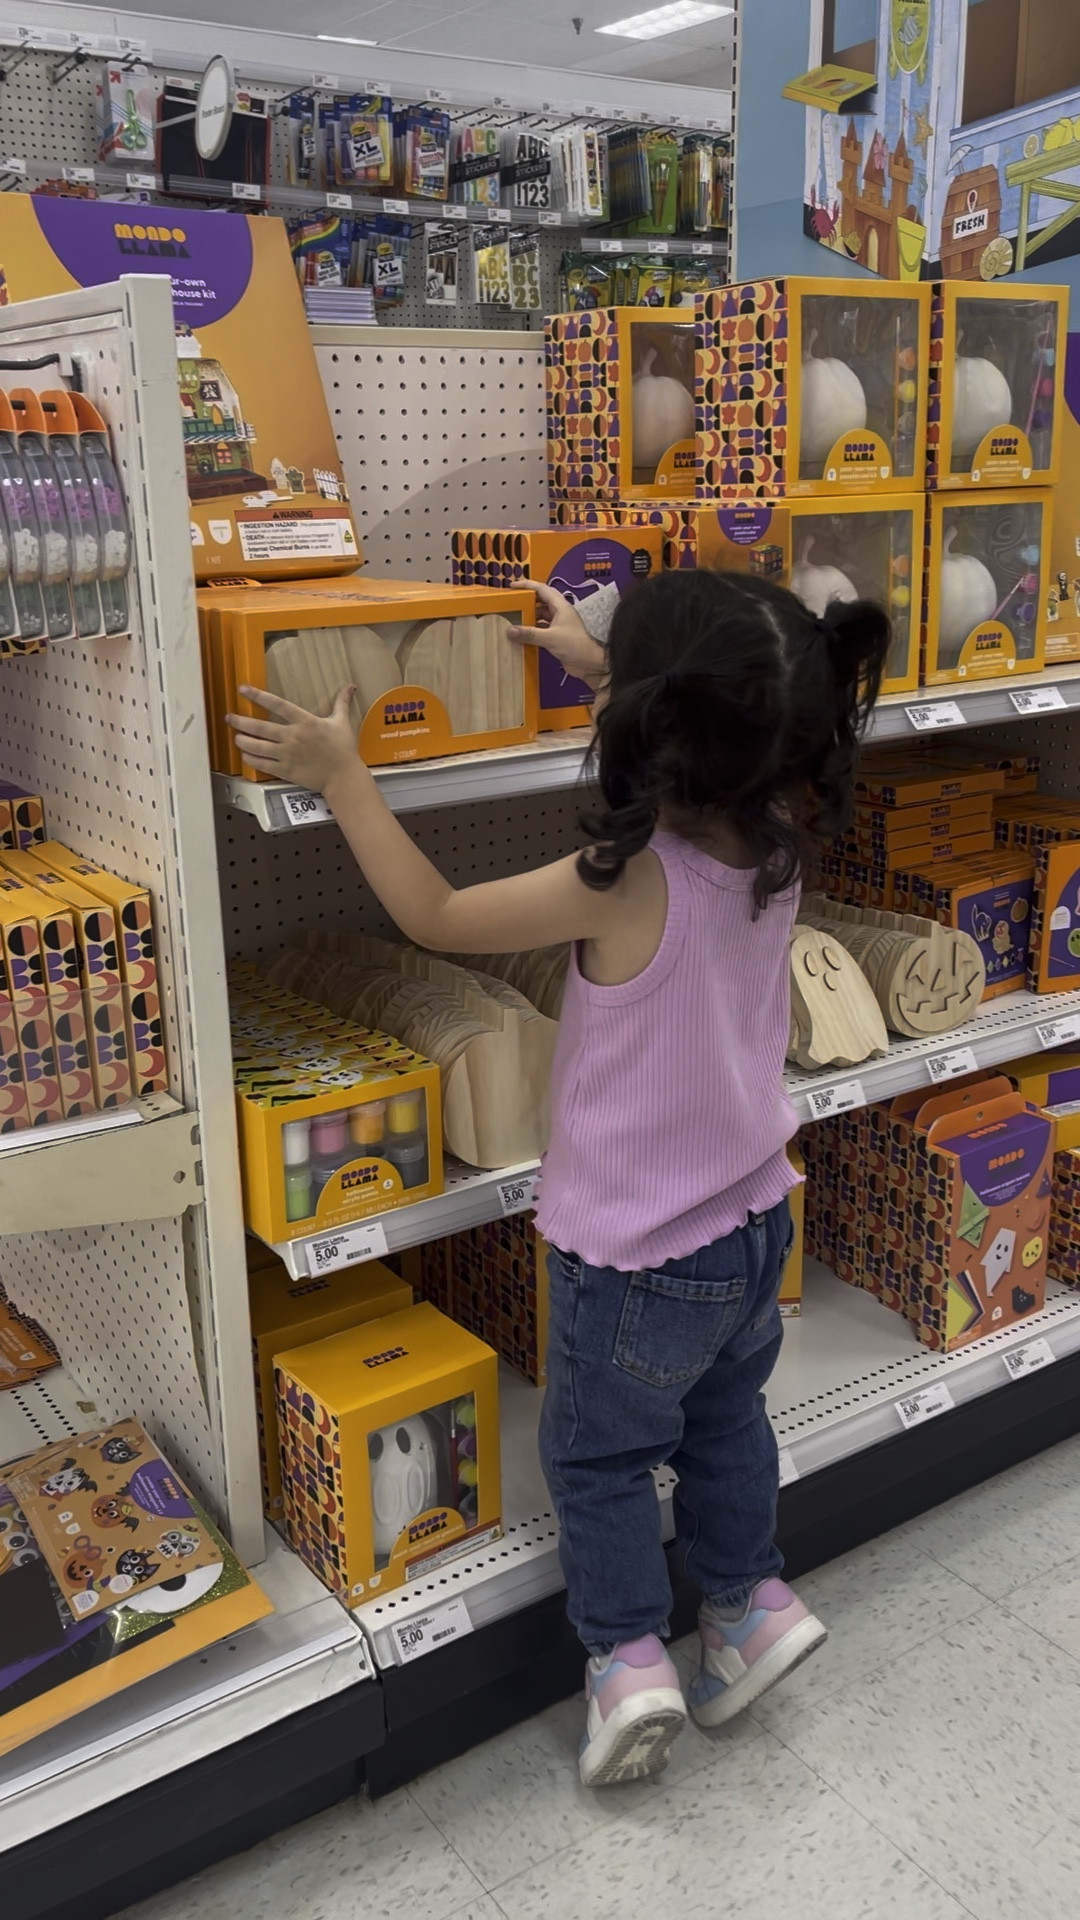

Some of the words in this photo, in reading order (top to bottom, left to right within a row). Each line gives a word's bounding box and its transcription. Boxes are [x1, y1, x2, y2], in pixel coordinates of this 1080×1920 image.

[353, 142, 378, 157] XL
[517, 183, 550, 207] !123
[955, 214, 985, 234] FRESH
[378, 262, 398, 276] XL
[202, 289, 217, 299] kit
[844, 453, 874, 462] LLAMA
[280, 510, 313, 519] WARNING
[384, 700, 425, 714] MONDO
[384, 711, 425, 726] LLAMA
[380, 730, 399, 739] wood
[290, 800, 316, 813] 5.00
[815, 1096, 831, 1109] 5.00
[341, 1164, 379, 1181] MONDO
[341, 1174, 379, 1190] LLAMA
[504, 1188, 525, 1203] 5.00
[312, 1240, 329, 1249] Mondo
[330, 1235, 345, 1244] Llama
[315, 1245, 339, 1262] 5.00
[367, 1351, 410, 1369] LLAMA
[903, 1403, 920, 1417] 5.00
[409, 1511, 448, 1534] MONDO
[408, 1520, 448, 1544] LLAMA
[400, 1628, 424, 1648] 5.00
